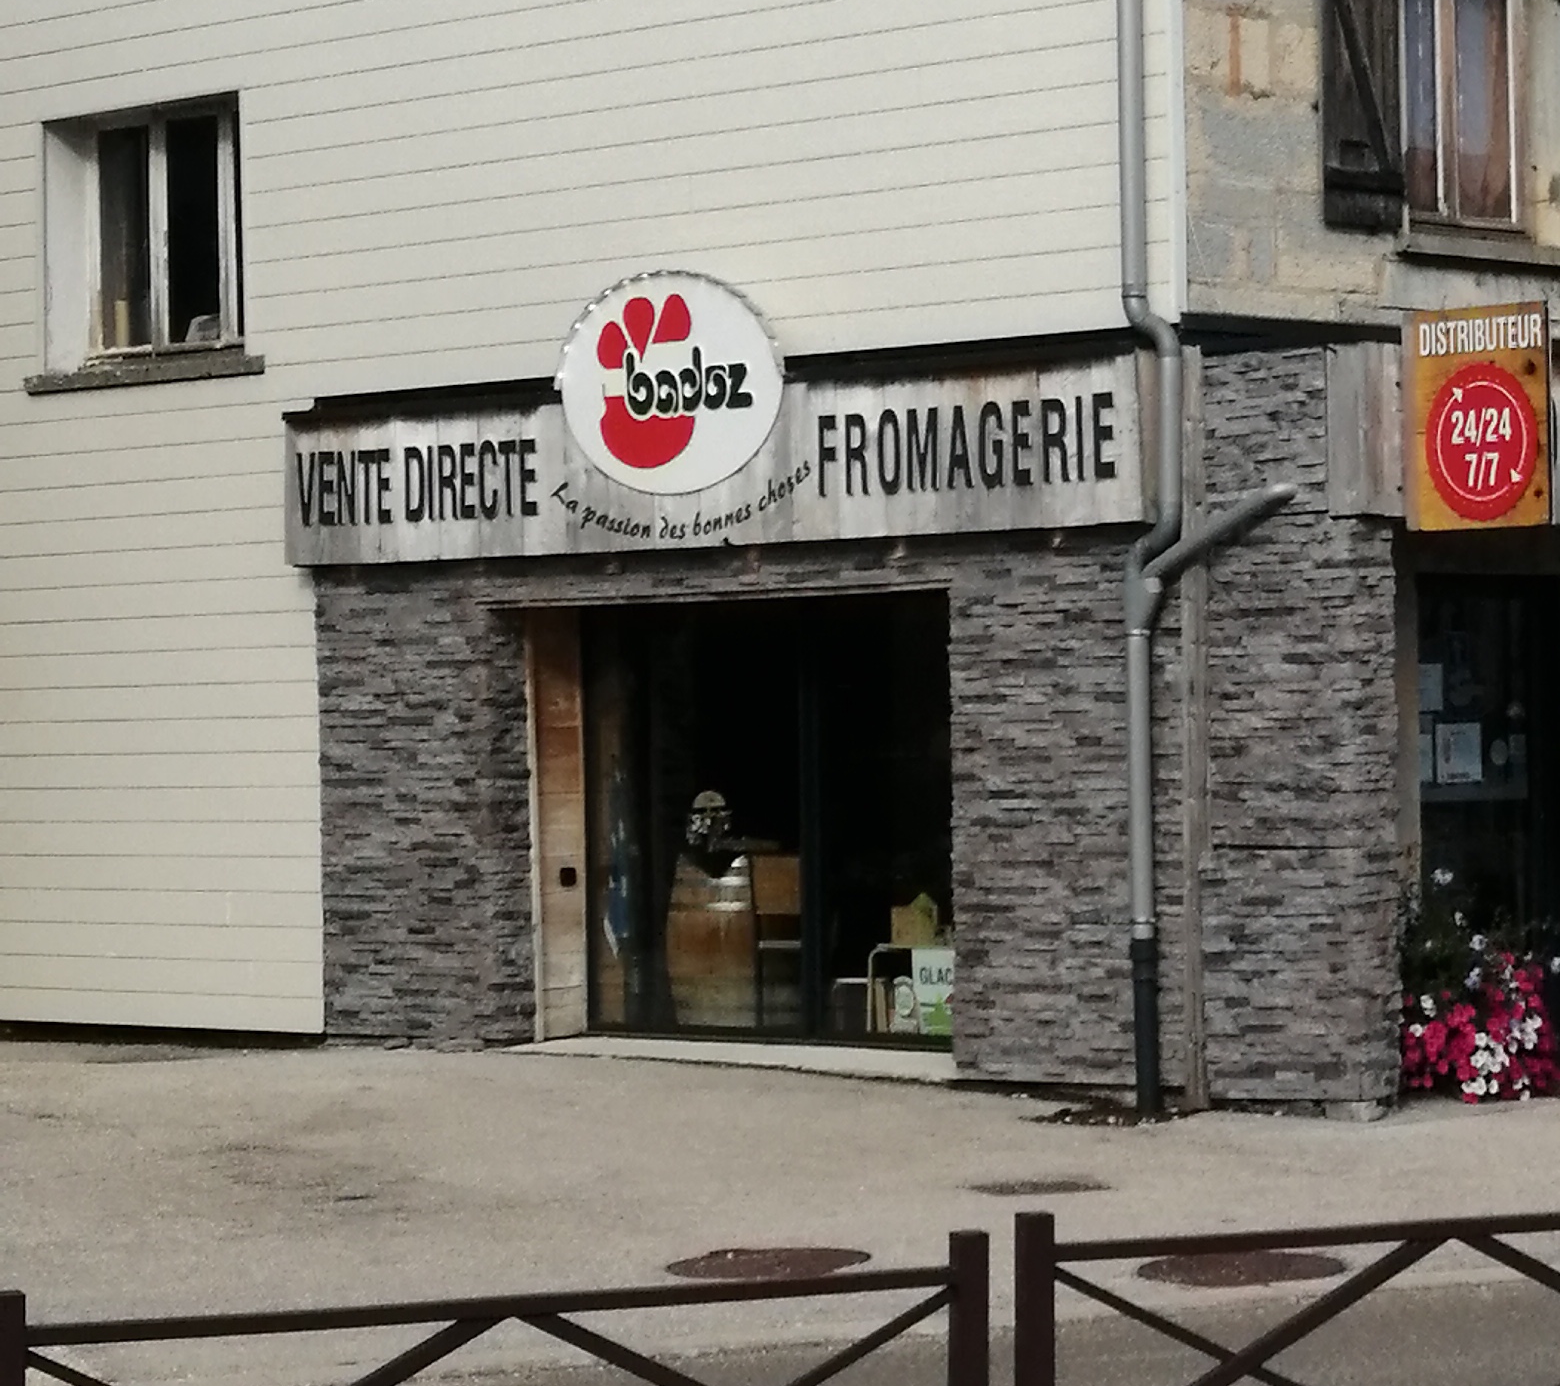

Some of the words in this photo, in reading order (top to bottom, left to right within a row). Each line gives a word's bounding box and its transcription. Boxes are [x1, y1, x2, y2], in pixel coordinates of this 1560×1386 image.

[1419, 313, 1542, 357] DISTRIBUTEUR
[625, 346, 753, 416] badoz
[817, 391, 1117, 498] FROMAGERIE
[1451, 407, 1512, 447] 24/24
[296, 448, 394, 527] VENTE
[404, 439, 539, 522] DIRECTE
[551, 482, 579, 513] La
[581, 507, 651, 539] passion
[659, 517, 686, 540] des
[692, 503, 751, 537] bonnes
[758, 460, 812, 511] choses
[1464, 451, 1500, 491] 7/7
